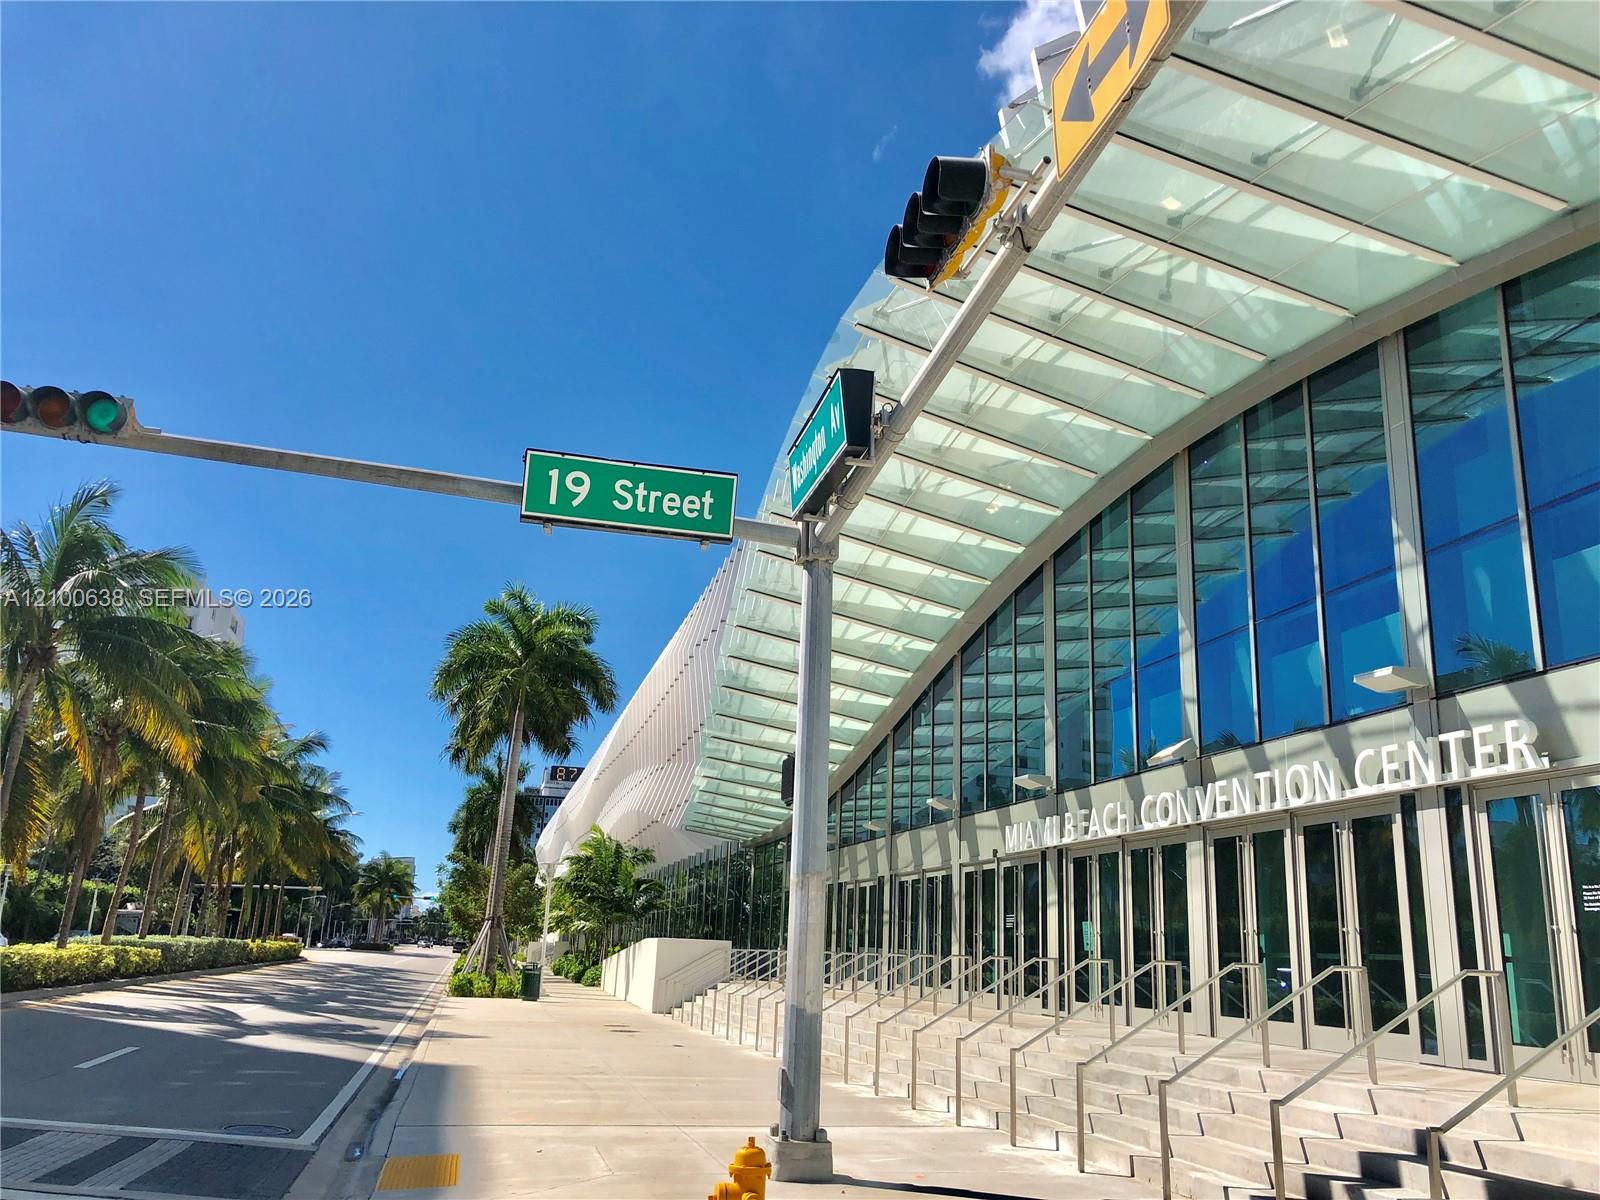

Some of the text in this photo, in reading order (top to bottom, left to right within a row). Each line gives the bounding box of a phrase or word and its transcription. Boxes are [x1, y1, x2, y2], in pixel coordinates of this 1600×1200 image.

[549, 468, 714, 520] 19 Street
[791, 402, 841, 494] Washington Av
[1004, 719, 1539, 852] MIAMI BEACH CONVENTION CENTER
